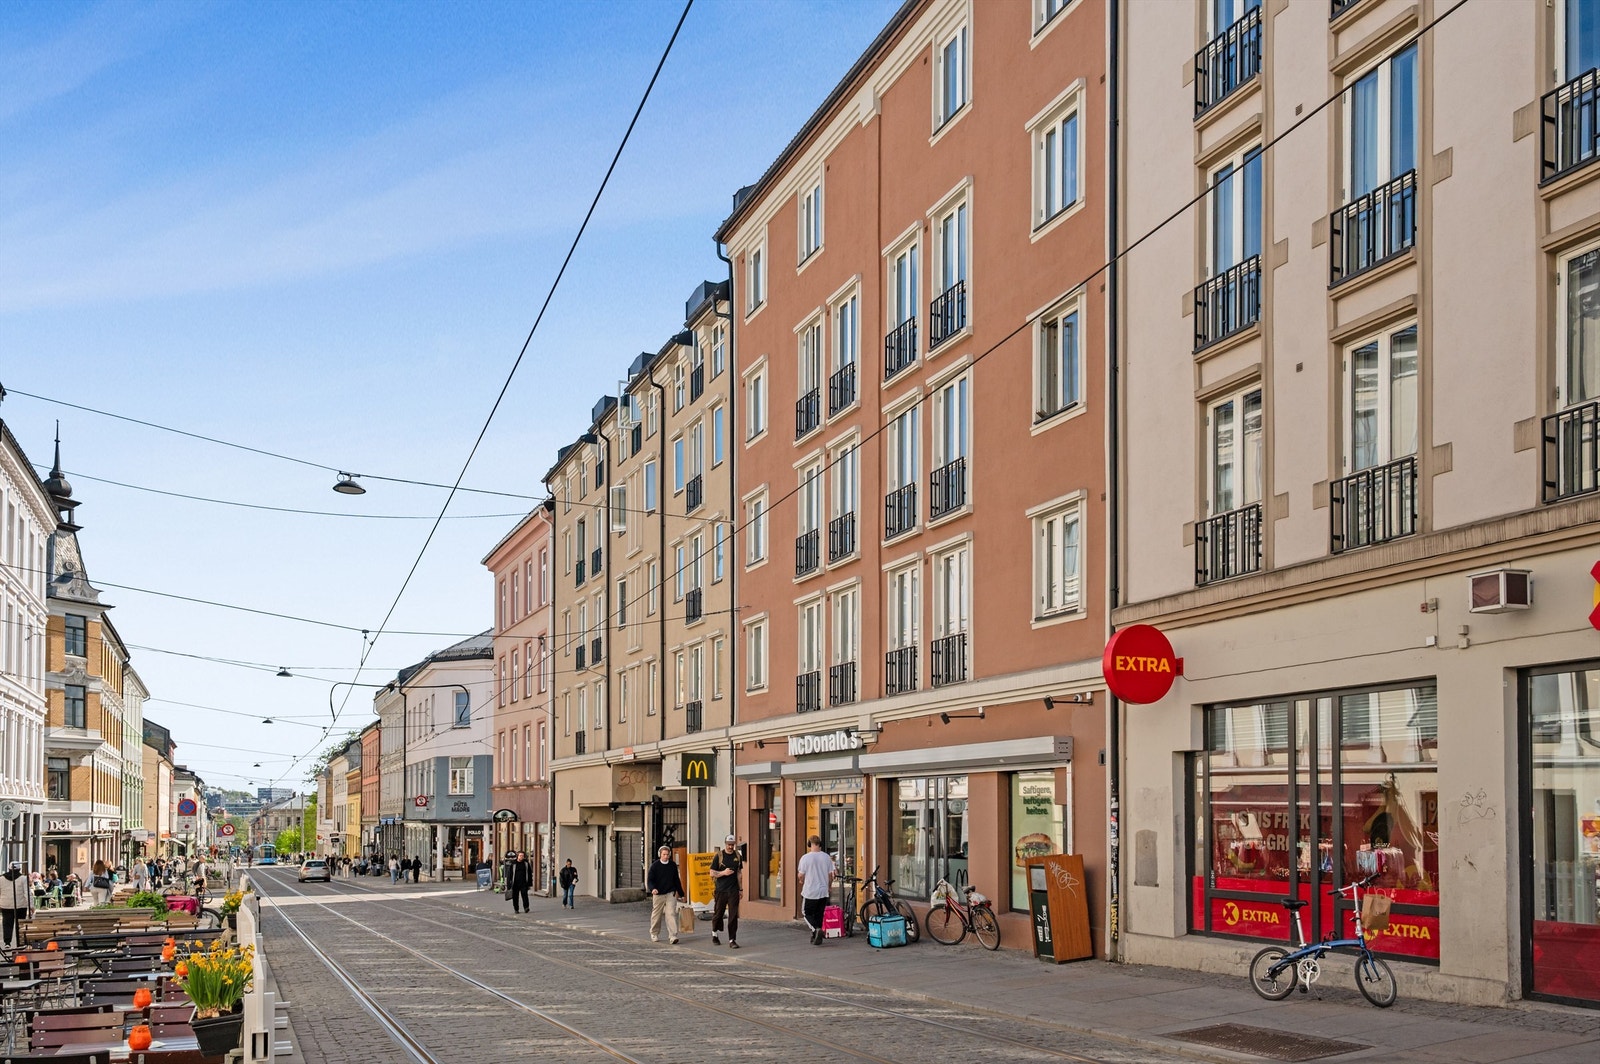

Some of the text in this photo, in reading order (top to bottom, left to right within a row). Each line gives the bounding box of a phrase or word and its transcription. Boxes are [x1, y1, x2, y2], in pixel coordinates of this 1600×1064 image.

[1115, 655, 1171, 673] EXTRA
[788, 730, 858, 756] McDonalds
[1022, 785, 1052, 796] Saftigere,
[47, 819, 72, 831] Deli
[1242, 909, 1279, 924] EXTRA
[1383, 922, 1431, 940] EXTRA
